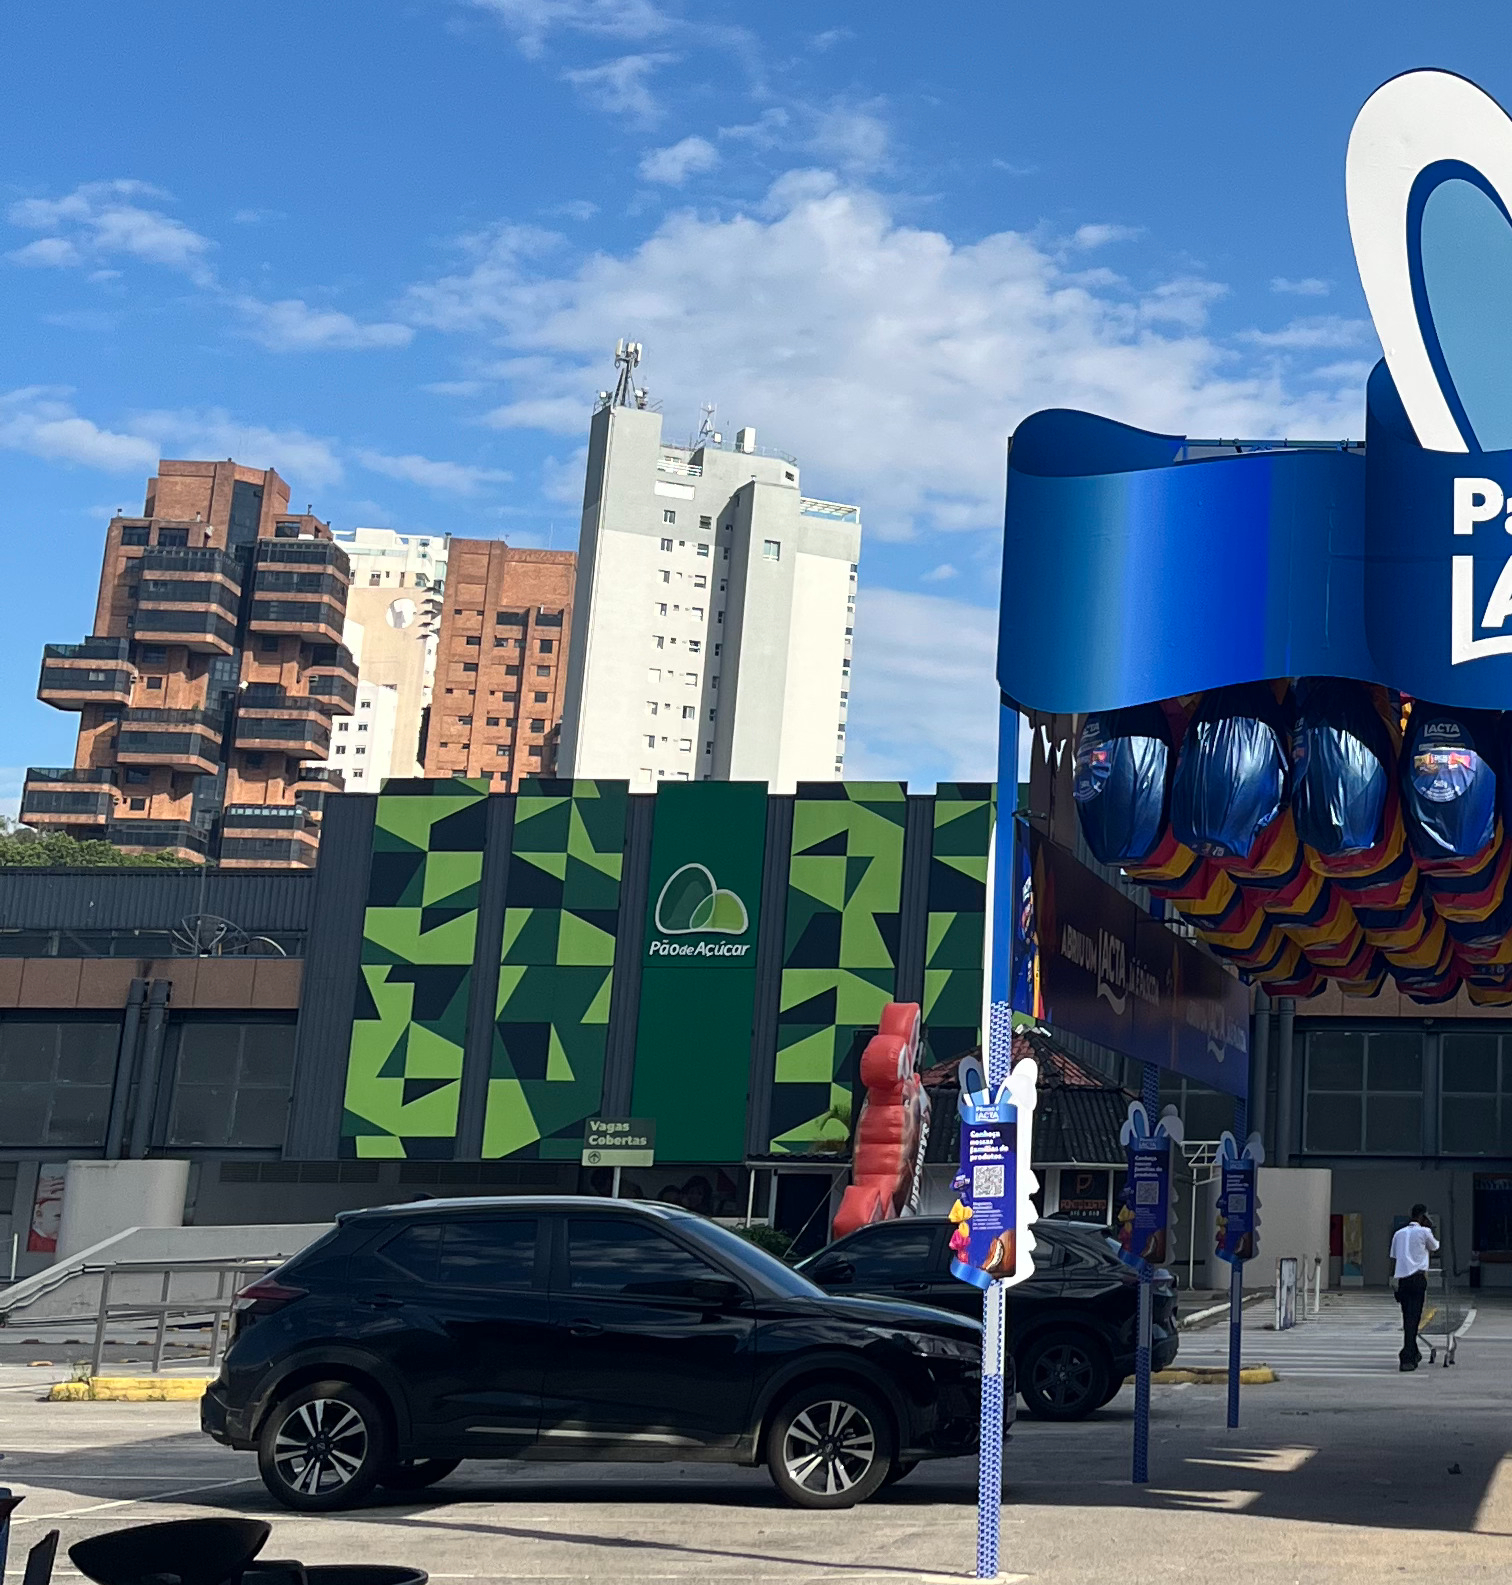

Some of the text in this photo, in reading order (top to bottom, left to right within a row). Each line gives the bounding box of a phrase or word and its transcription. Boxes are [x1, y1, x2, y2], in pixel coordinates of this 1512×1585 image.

[1424, 723, 1461, 737] LACTA
[589, 1121, 630, 1134] Vagas
[588, 1135, 647, 1146] Cobertas
[969, 1130, 1001, 1139] Conheça
